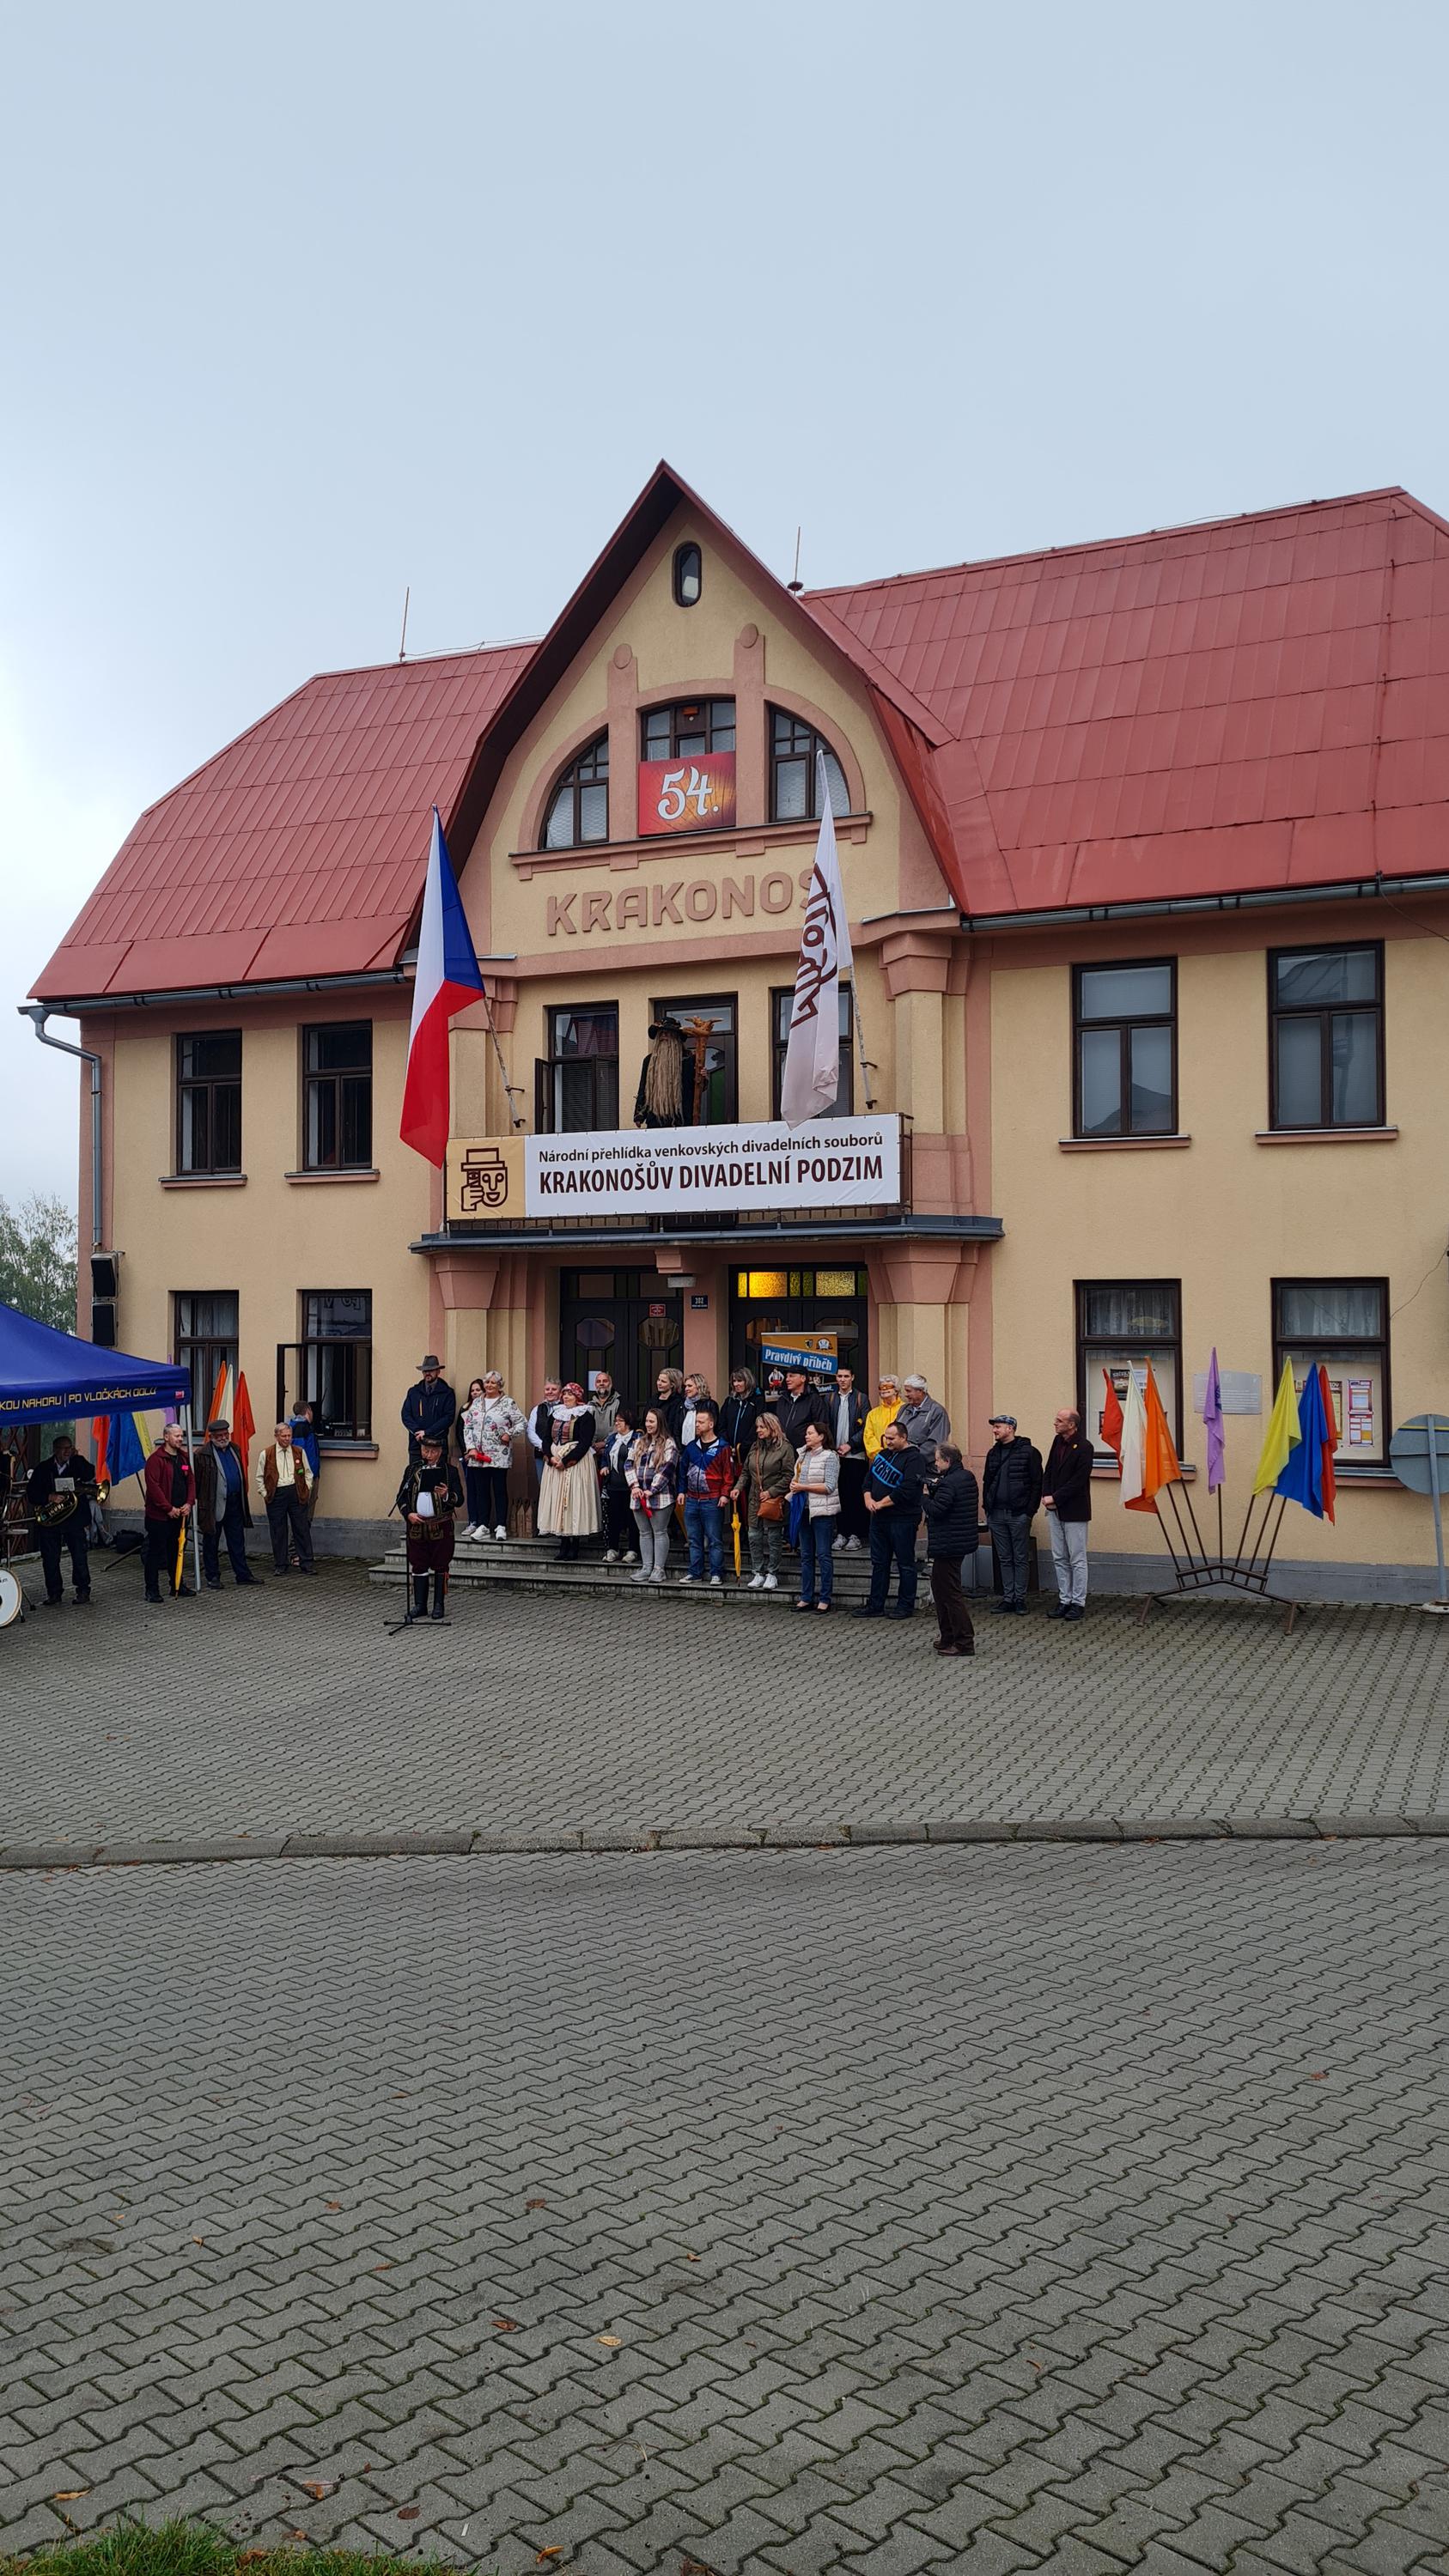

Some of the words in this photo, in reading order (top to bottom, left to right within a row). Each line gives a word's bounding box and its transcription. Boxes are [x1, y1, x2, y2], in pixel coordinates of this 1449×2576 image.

[656, 765, 720, 822] 54.
[539, 1148, 589, 1163] Národní
[592, 1145, 652, 1163] přehlídka
[654, 1140, 739, 1157] venkovských
[742, 1136, 821, 1153] divadelních
[824, 1131, 883, 1148] souborů
[539, 1160, 673, 1194] KRAKONOŠŮV
[679, 1155, 790, 1189] DIVADELNÍ
[797, 1155, 883, 1183] PODZIM
[764, 1348, 801, 1365] Pravdivý
[802, 1355, 832, 1371] příběh
[21, 1396, 62, 1409] NAHORU
[68, 1394, 82, 1404] PO
[84, 1387, 131, 1402] VLOČKÁCH
